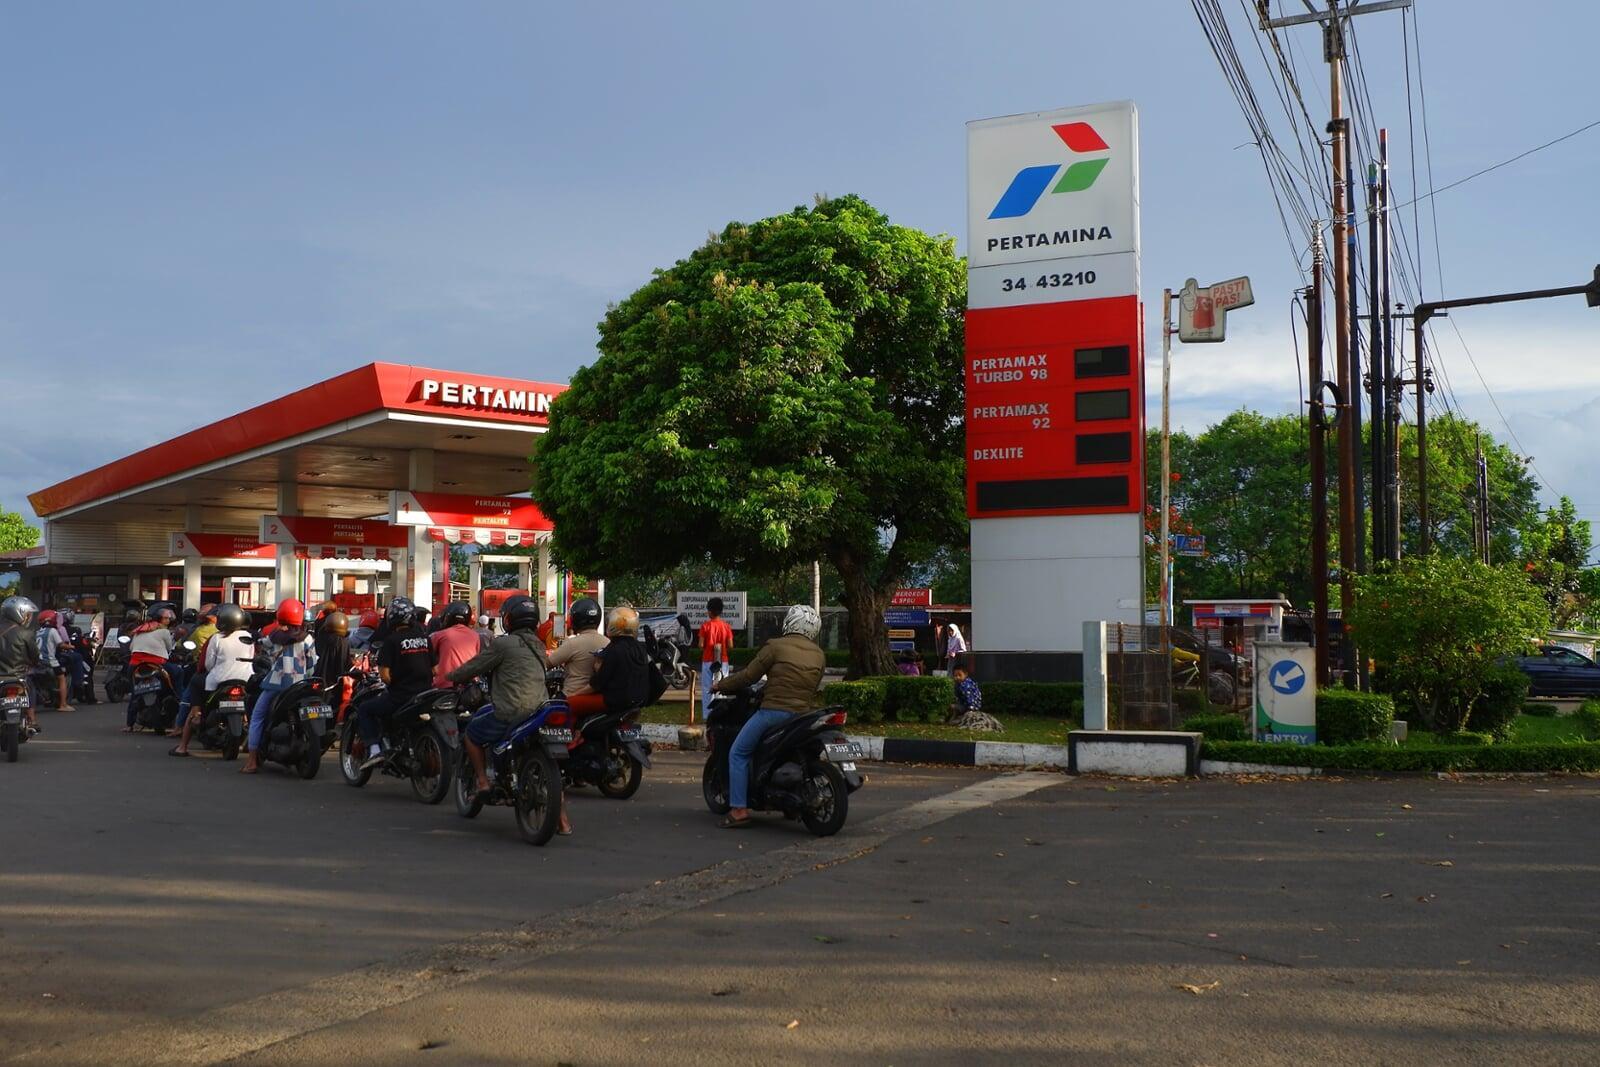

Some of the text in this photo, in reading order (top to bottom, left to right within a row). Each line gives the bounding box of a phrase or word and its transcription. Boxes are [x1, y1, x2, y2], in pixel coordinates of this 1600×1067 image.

[988, 226, 1112, 252] PERTAMINA
[1213, 280, 1245, 298] PASTI
[1215, 292, 1241, 308] PAS!
[973, 354, 1047, 370] PERTAMAX
[973, 369, 1048, 384] TURBO 98
[423, 379, 553, 413] PERTAMIN
[973, 403, 1049, 418] PERTAMAX
[1032, 418, 1051, 429] 92
[973, 447, 1024, 460] DEXLITE
[402, 502, 410, 513] 1
[475, 500, 511, 508] PERTAMAX
[270, 524, 278, 535] 2
[176, 540, 184, 549] 3
[1265, 733, 1308, 744] ENTRY
